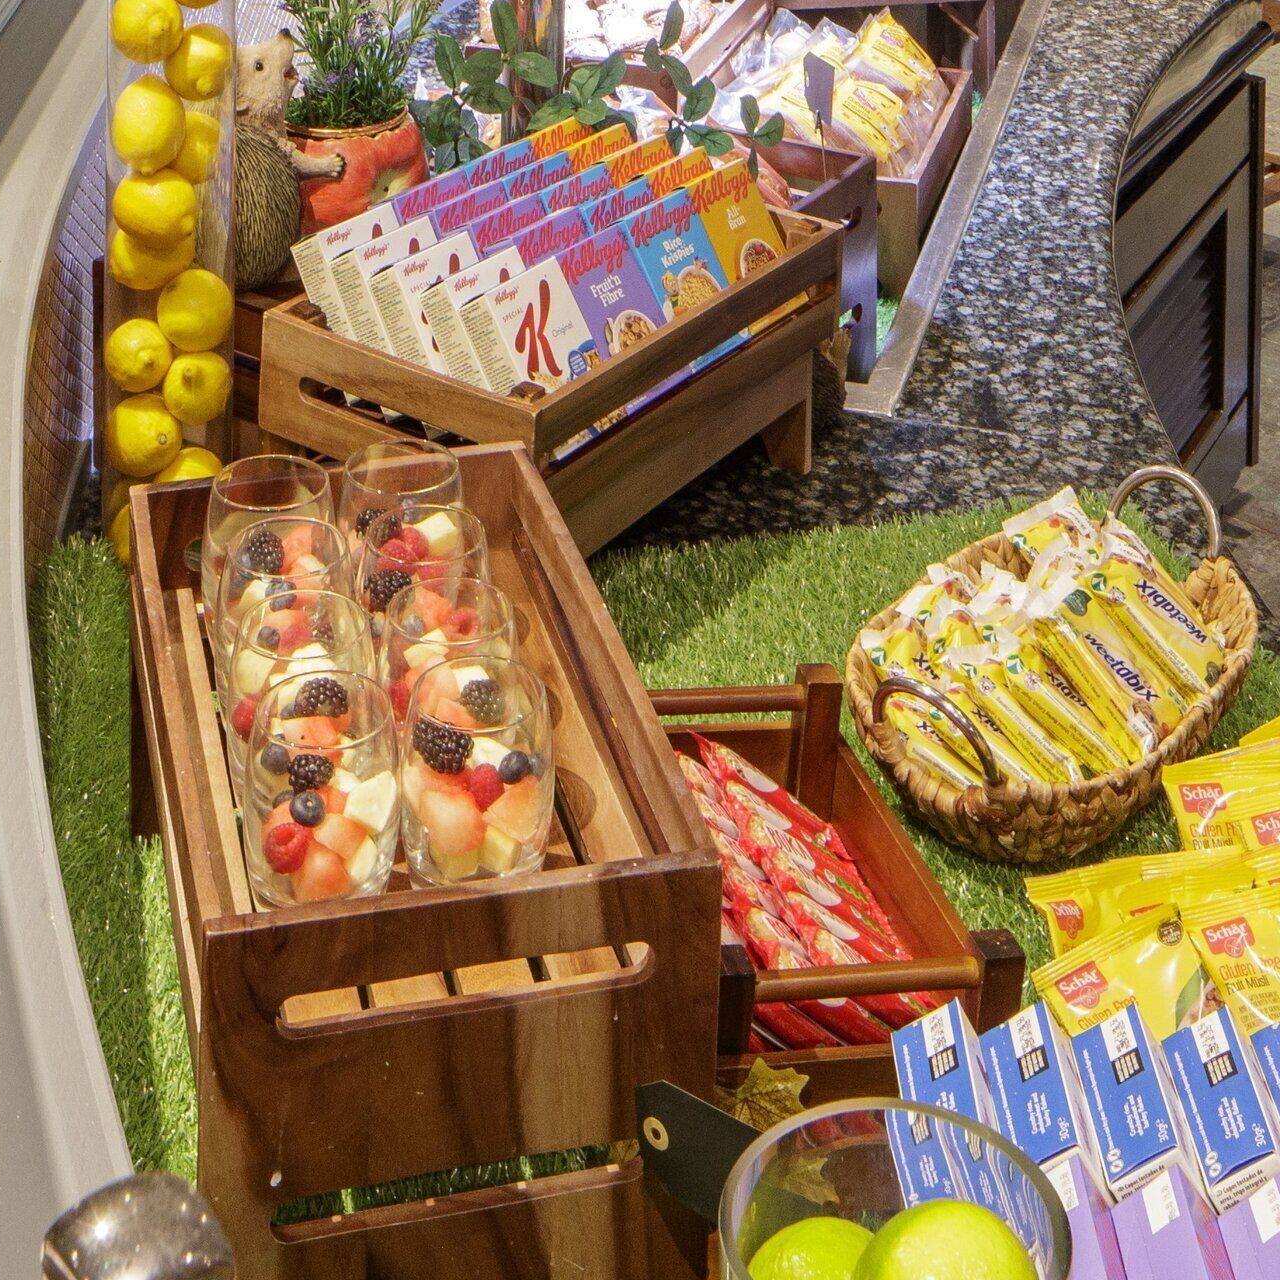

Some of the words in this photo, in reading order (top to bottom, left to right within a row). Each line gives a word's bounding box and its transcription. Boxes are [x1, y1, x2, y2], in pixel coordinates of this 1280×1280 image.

[693, 167, 755, 214] Kellogg's
[630, 194, 699, 248] Kellogg's
[728, 216, 746, 231] Bran
[662, 236, 684, 254] Rice
[560, 234, 629, 285] Kellogg's
[661, 243, 695, 270] Krispies
[589, 272, 621, 298] Fruit'n
[600, 287, 625, 307] Fibre
[502, 307, 524, 323] SPECIAL
[551, 320, 574, 339] Original
[1183, 786, 1221, 802] Schär
[1205, 922, 1247, 942] Schär
[1059, 968, 1101, 995] Schär
[1220, 962, 1255, 982] Gluten
[1246, 975, 1270, 989] Müsli
